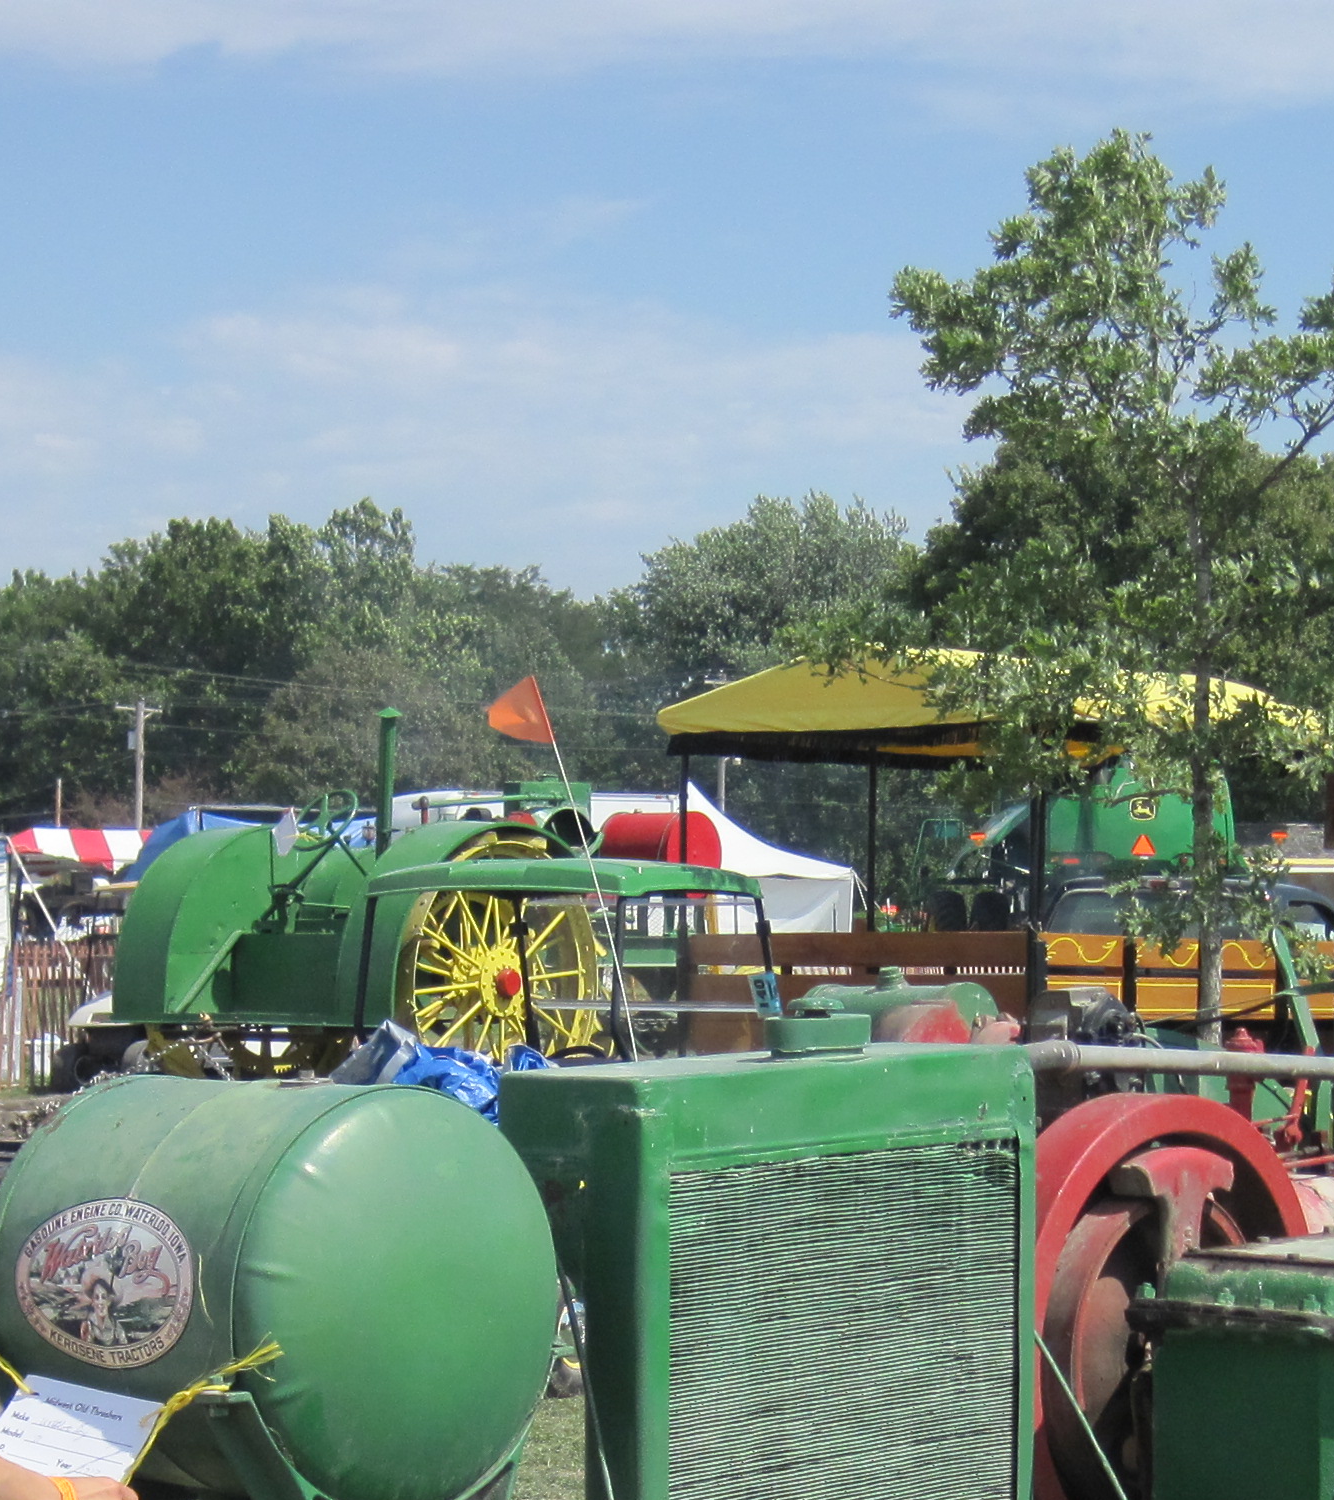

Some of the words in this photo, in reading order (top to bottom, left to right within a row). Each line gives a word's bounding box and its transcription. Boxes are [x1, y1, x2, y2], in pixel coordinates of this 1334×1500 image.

[70, 1202, 107, 1223] ENGINE
[49, 1329, 105, 1364] KEROSENE
[110, 1336, 165, 1364] TRACTORS
[75, 1402, 88, 1414] Old
[11, 1410, 29, 1422] Make
[55, 1458, 73, 1470] Year
